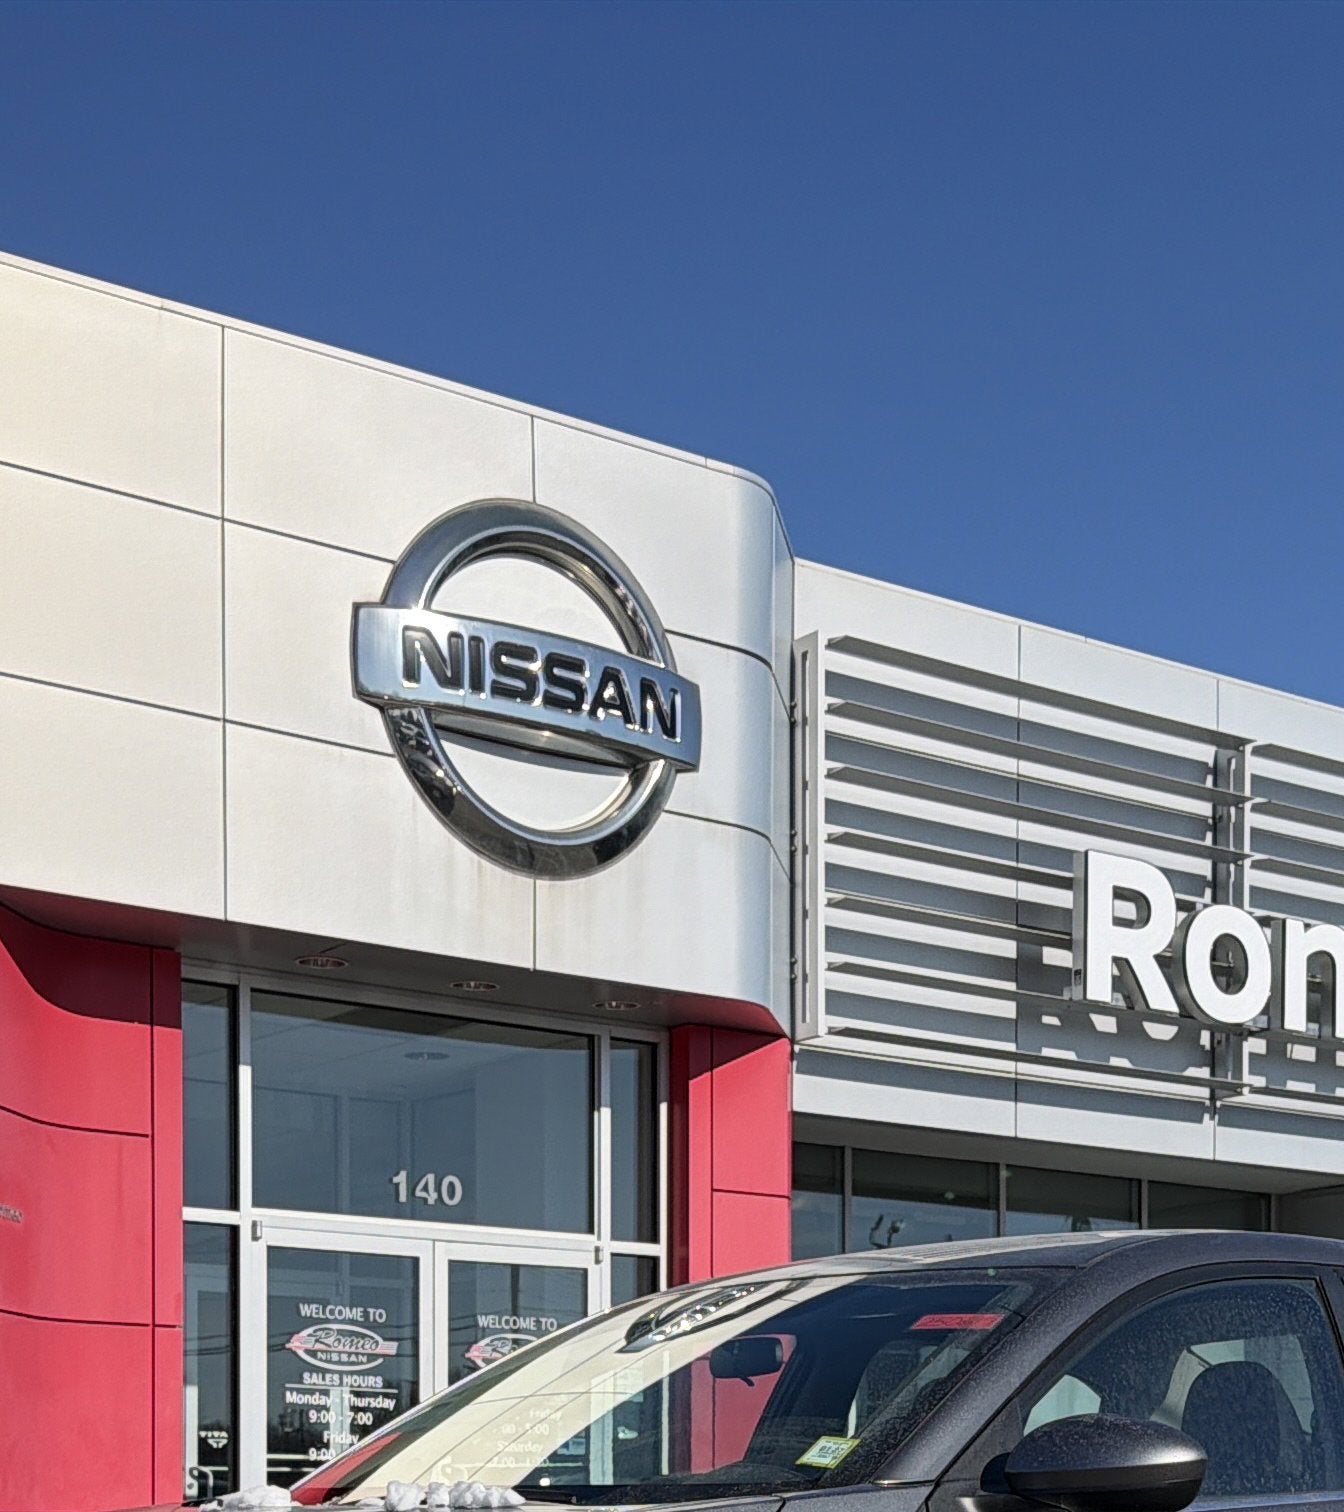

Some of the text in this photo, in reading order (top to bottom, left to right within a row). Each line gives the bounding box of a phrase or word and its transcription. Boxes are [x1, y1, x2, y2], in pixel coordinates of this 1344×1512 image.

[400, 624, 682, 743] NISSAN
[391, 1169, 463, 1206] 140
[299, 1303, 387, 1323] WELCOME TO
[477, 1314, 558, 1331] WELCOME TO
[311, 1327, 382, 1351] Romeo
[317, 1353, 367, 1363] NISSAN
[302, 1371, 383, 1388] SALES HOURS
[285, 1390, 332, 1407] Monday
[343, 1393, 396, 1411] Thursday
[308, 1411, 336, 1424] 9:00
[346, 1412, 373, 1425] 7:00
[323, 1430, 360, 1444] Friday
